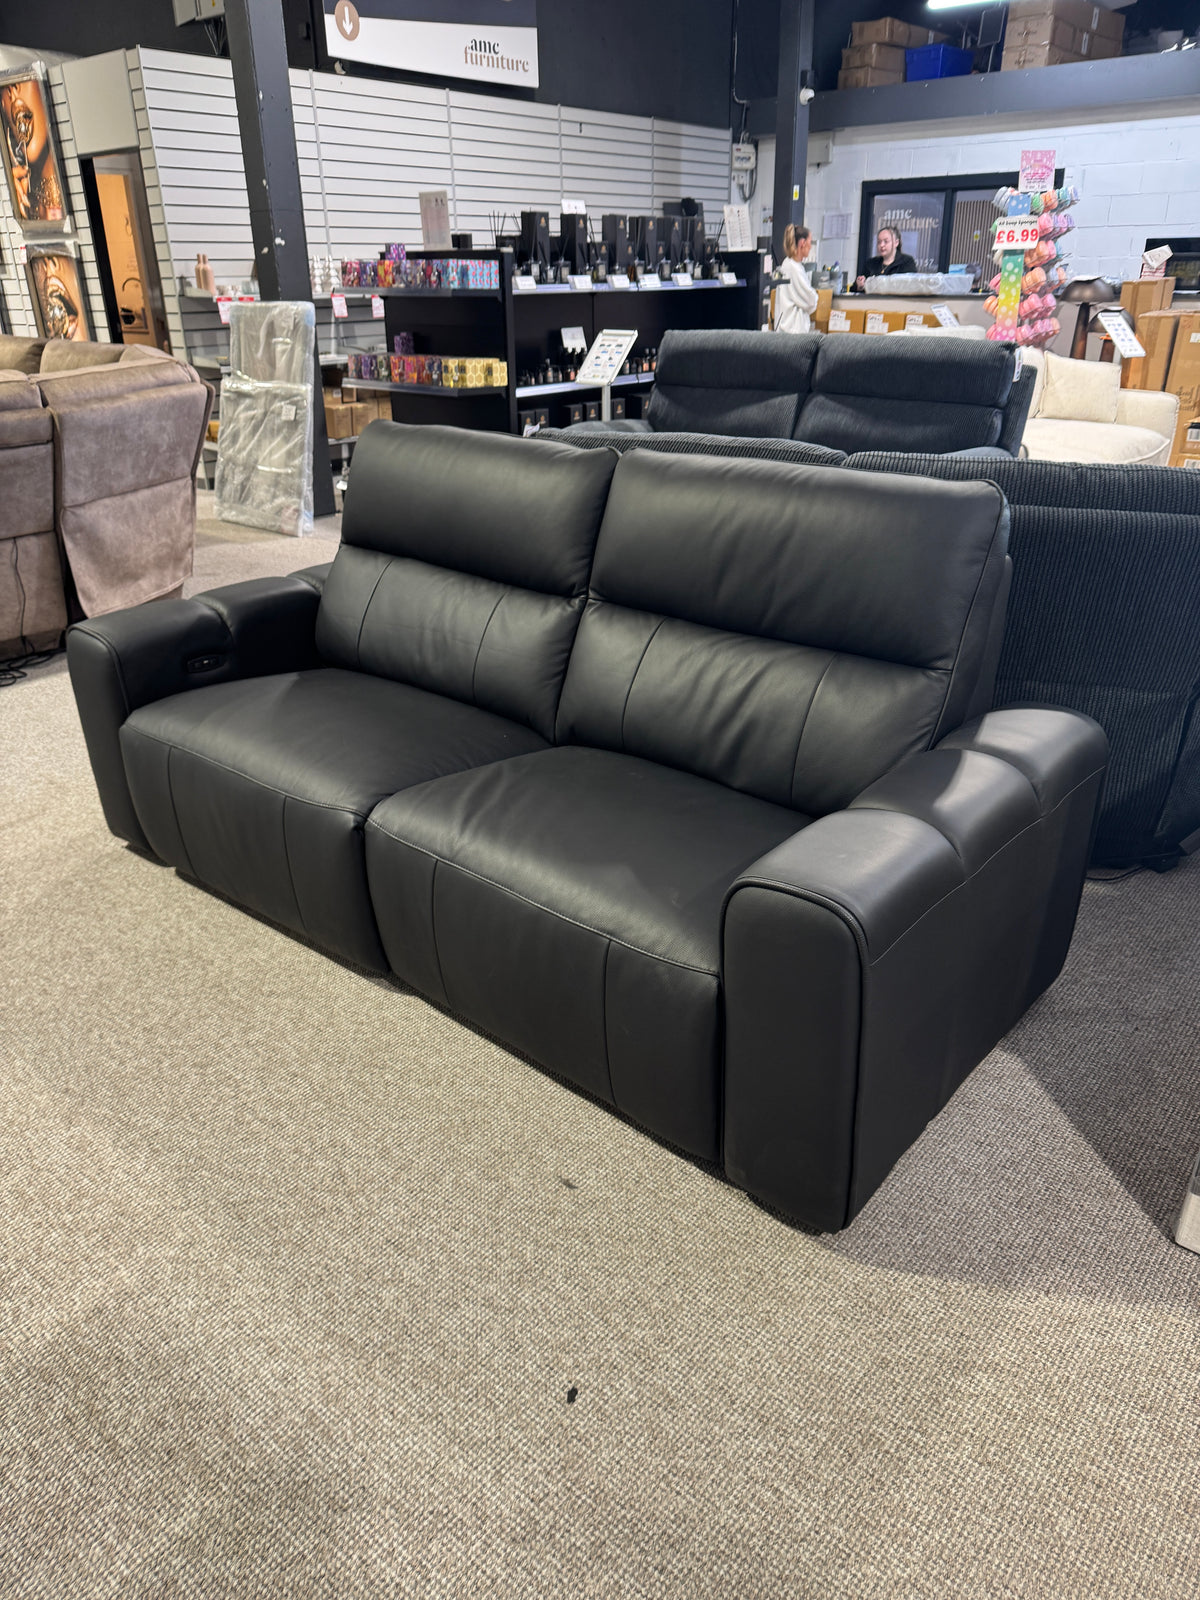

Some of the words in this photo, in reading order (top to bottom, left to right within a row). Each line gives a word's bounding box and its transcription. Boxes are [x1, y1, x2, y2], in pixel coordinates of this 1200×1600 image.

[470, 38, 500, 55] amc
[464, 45, 529, 73] furniture
[883, 208, 913, 220] amc
[996, 228, 1039, 244] £6.99
